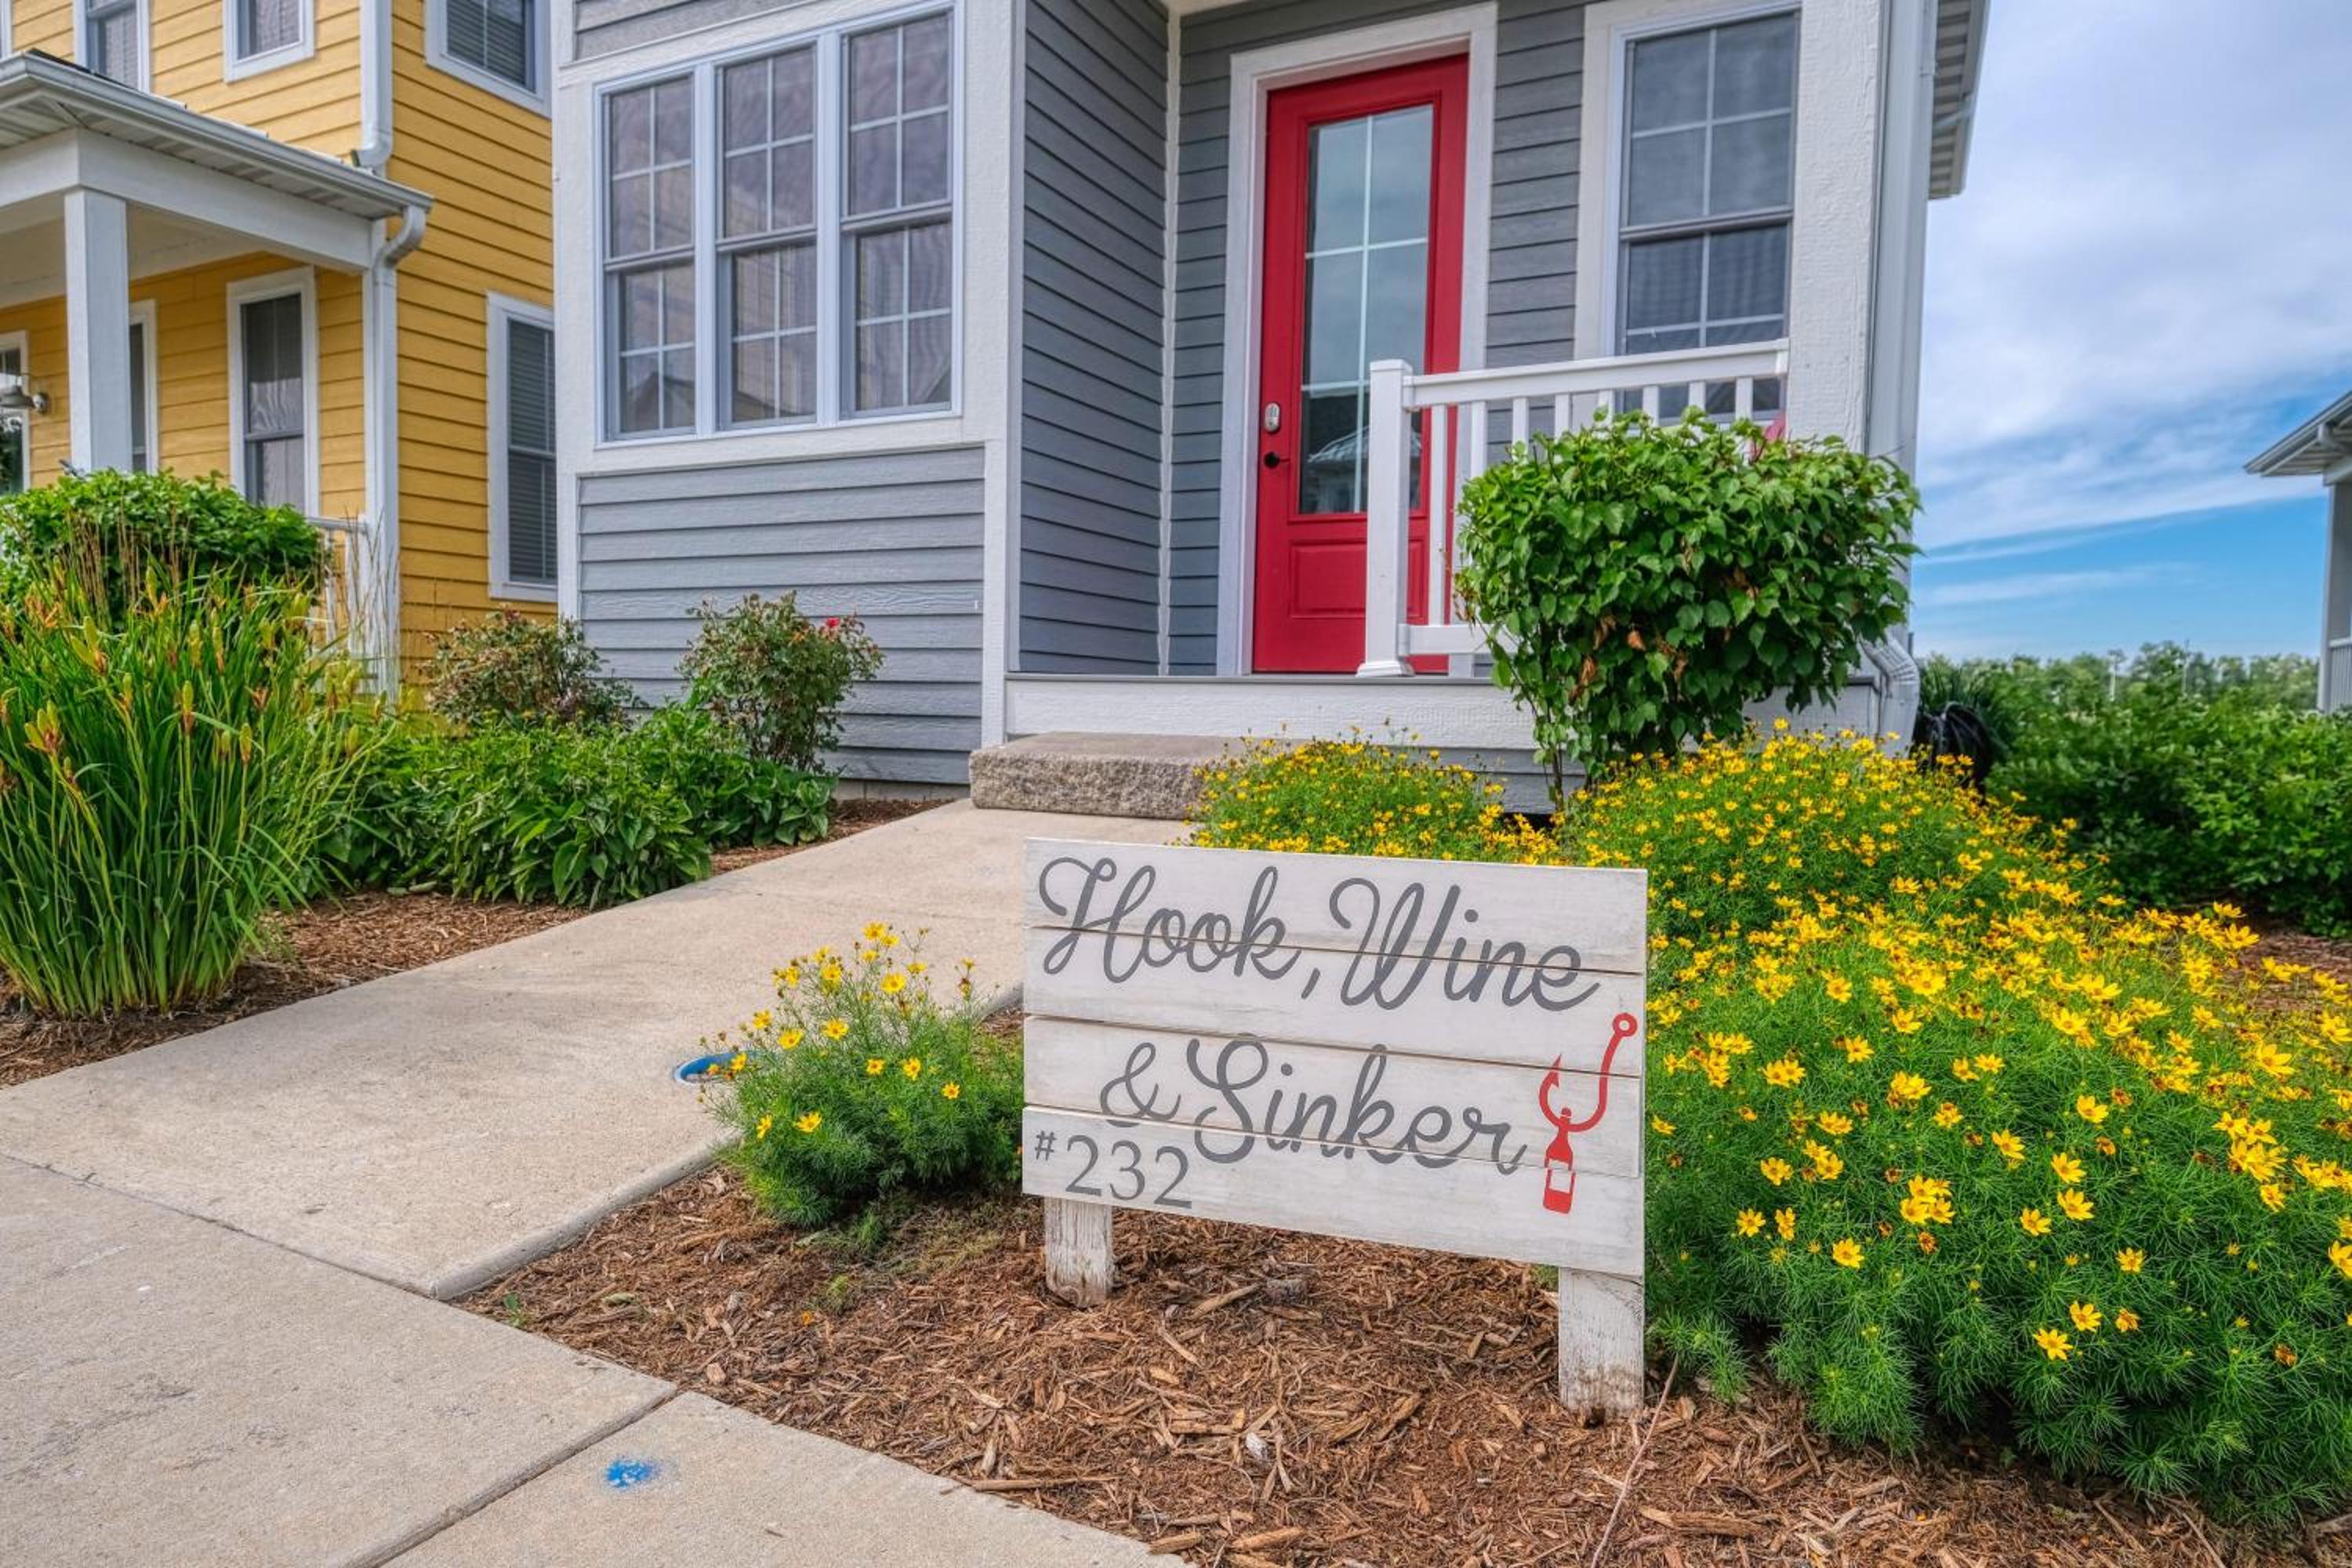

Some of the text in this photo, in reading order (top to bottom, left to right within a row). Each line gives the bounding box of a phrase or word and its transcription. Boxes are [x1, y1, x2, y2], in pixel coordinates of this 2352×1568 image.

[1039, 856, 1600, 1011] Hook, Wine
[1035, 1129, 1192, 1210] #232
[1100, 1033, 1527, 1174] & Sinker
